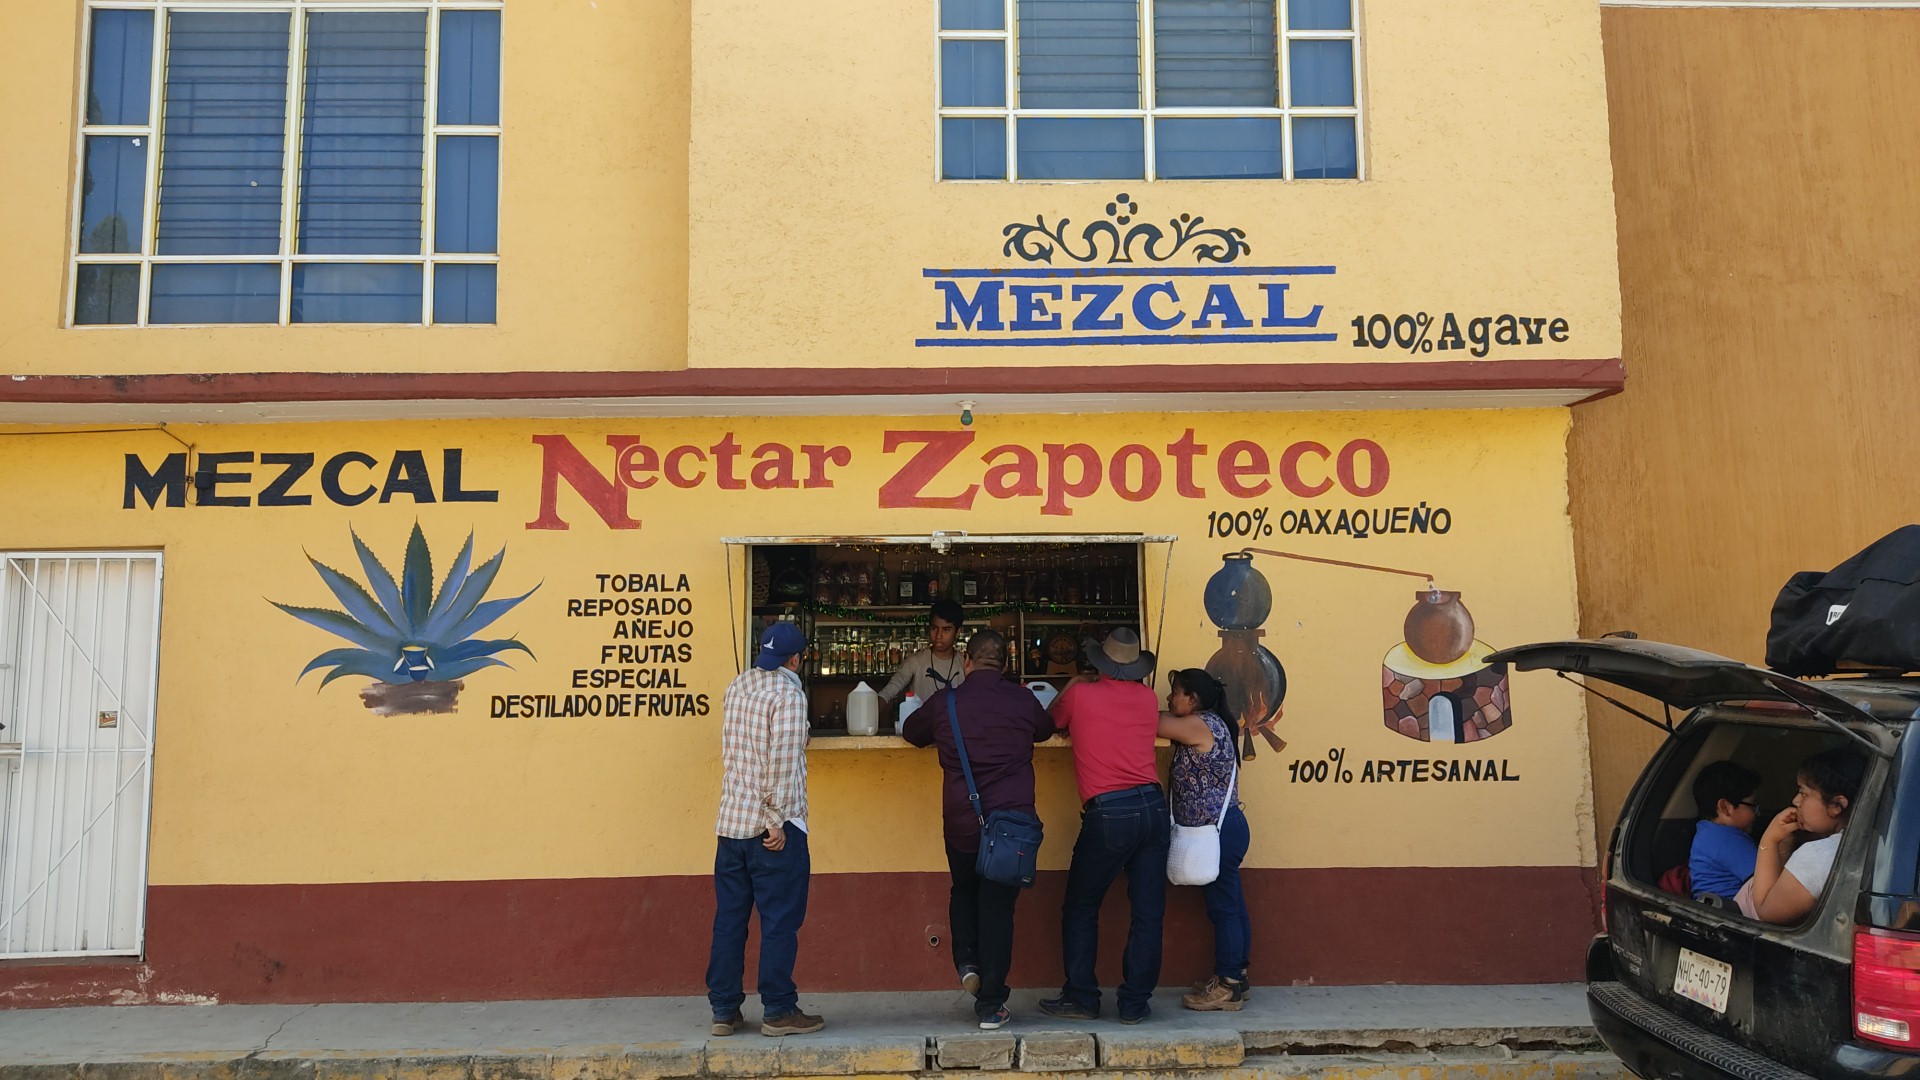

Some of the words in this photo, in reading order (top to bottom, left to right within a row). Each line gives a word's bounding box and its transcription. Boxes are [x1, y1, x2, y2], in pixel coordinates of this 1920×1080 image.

[934, 280, 1324, 332] MEZCAL
[122, 448, 499, 511] MEZCAL
[525, 431, 852, 531] Nectar
[878, 427, 1391, 517] Zapoteco
[1207, 506, 1273, 540] 100%
[1279, 501, 1452, 539] OAXAQUEÑO
[595, 573, 691, 593] TOBALA
[567, 597, 693, 617] REPOSADO
[612, 617, 694, 639] AÑEJO
[600, 643, 692, 664] FRUTAS
[571, 668, 687, 689] ESPECIAL
[490, 694, 602, 719] DESTILADO
[605, 694, 632, 718] DE
[633, 693, 710, 718] FRUTAS
[1288, 747, 1354, 784] 100%
[1360, 759, 1521, 783] ARTESANAL
[1677, 959, 1727, 996] NHC-40-79
